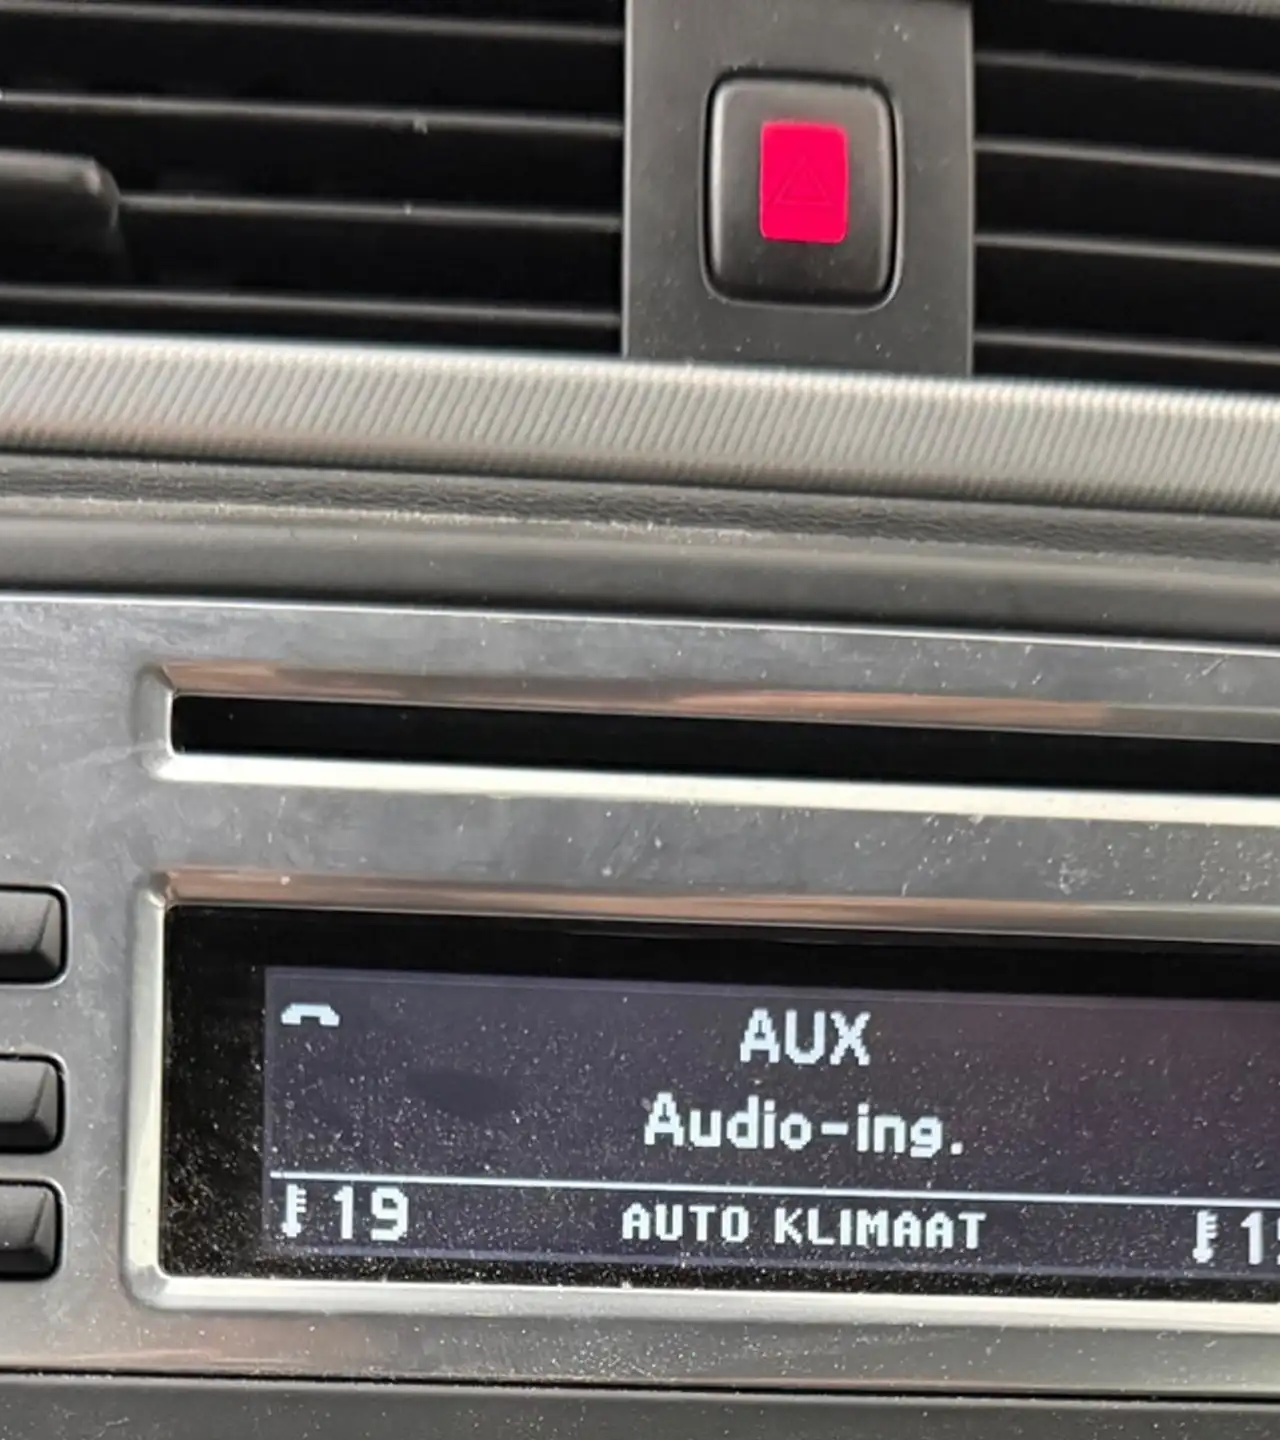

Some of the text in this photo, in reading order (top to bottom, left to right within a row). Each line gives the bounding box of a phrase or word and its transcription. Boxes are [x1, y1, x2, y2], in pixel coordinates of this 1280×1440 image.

[739, 1008, 871, 1066] AUX
[644, 1092, 963, 1158] Audio-ing.
[330, 1183, 411, 1242] 19
[622, 1202, 987, 1256] AUTO KLIMAAT
